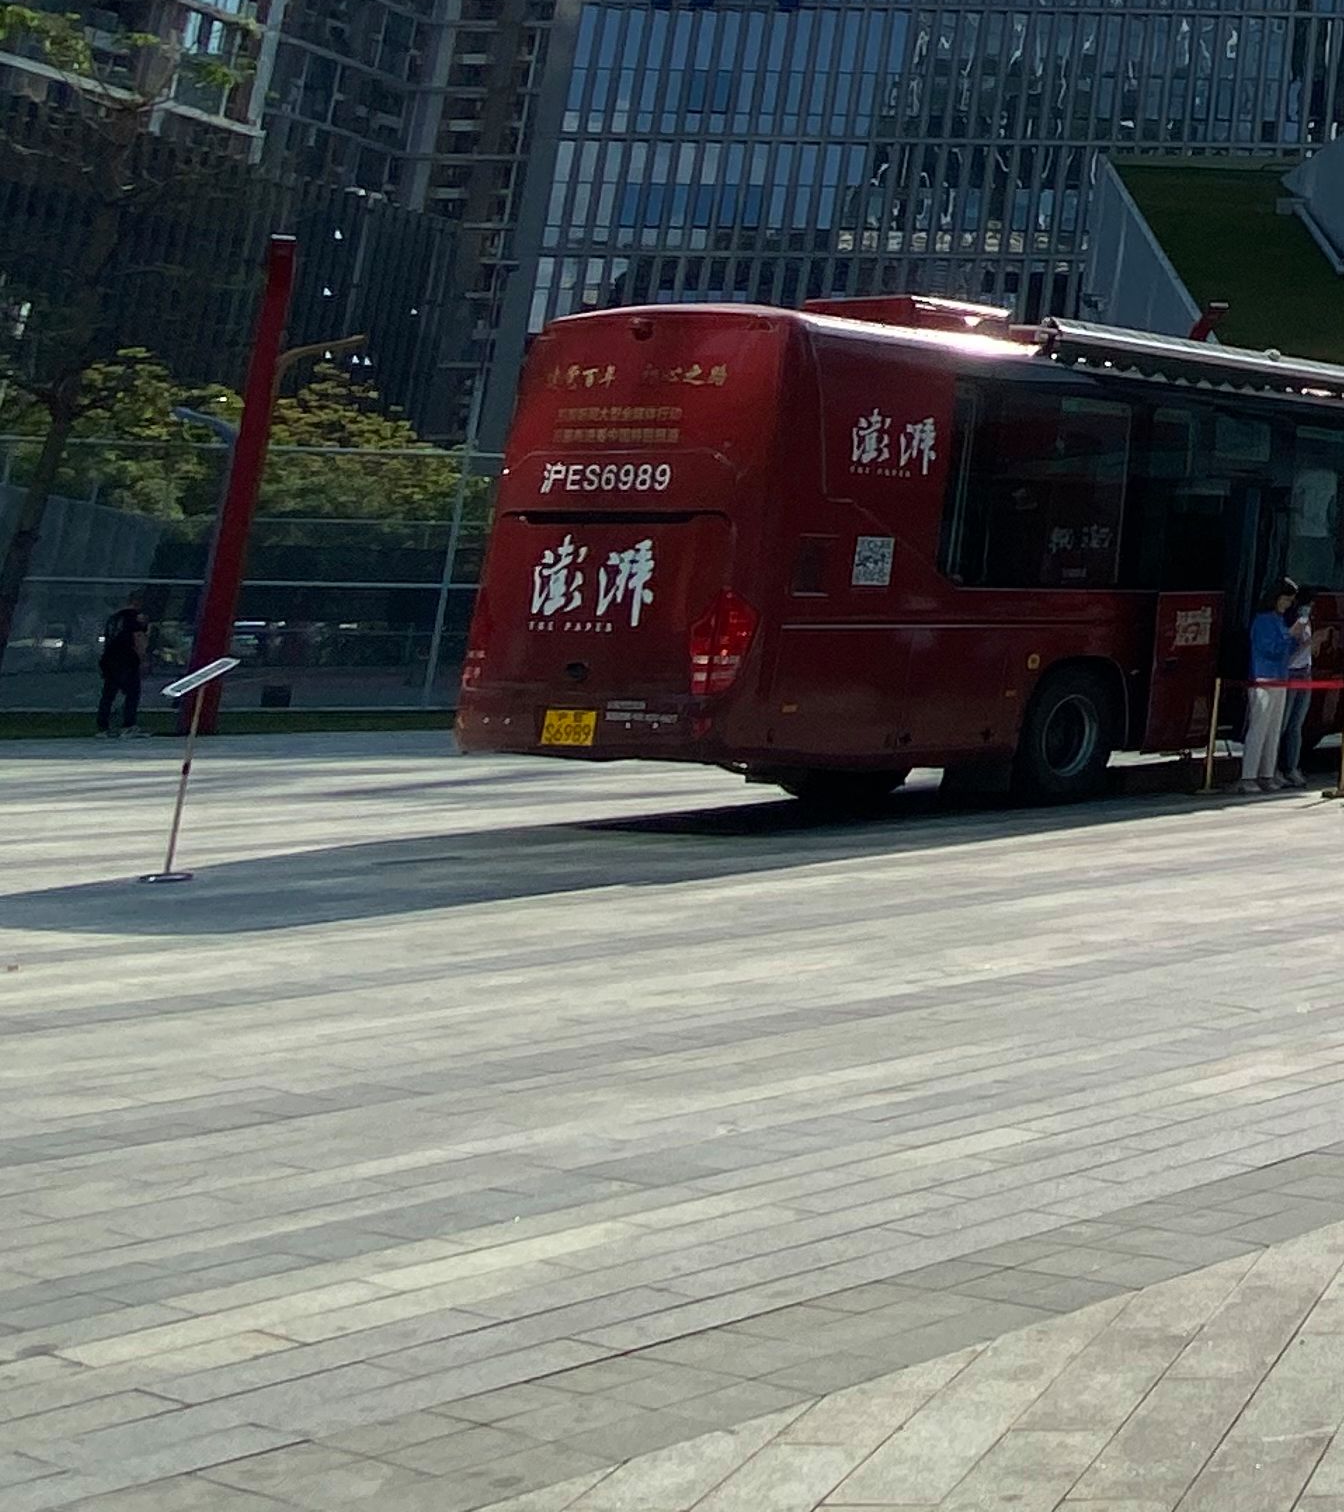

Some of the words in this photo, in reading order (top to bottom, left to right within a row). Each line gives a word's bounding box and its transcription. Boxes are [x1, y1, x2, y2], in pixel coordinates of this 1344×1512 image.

[852, 407, 937, 476] 澎湃
[540, 462, 671, 494] 沪ES6989
[531, 534, 655, 627] 澎湃
